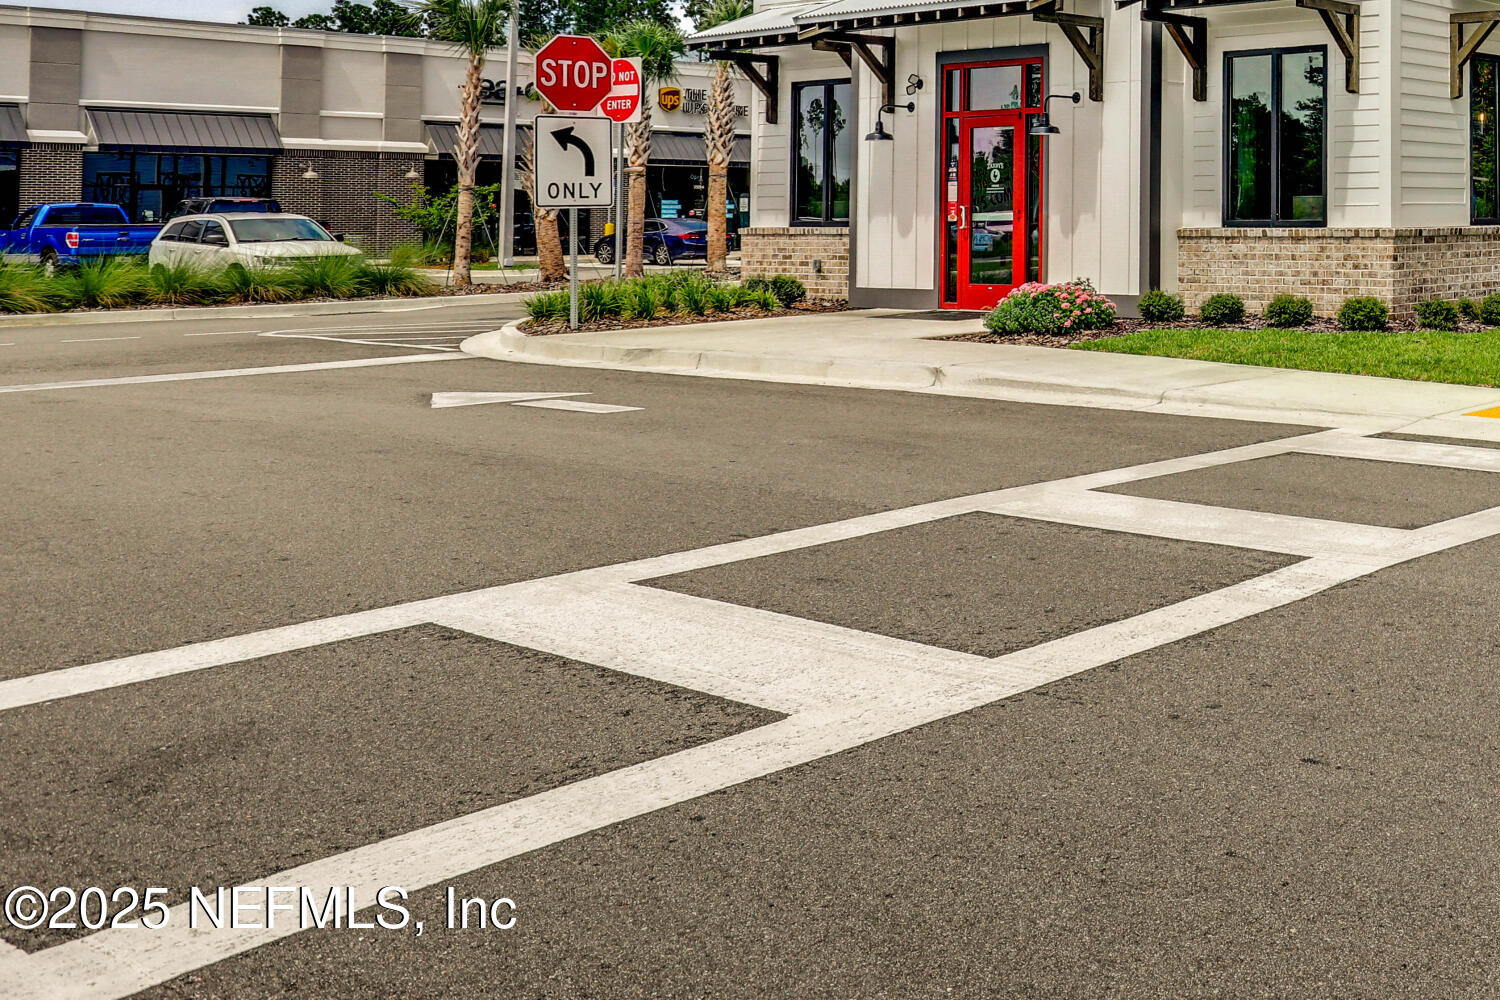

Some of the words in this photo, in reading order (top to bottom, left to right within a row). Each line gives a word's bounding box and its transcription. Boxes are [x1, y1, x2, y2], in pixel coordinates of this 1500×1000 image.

[540, 58, 608, 89] STOP
[619, 71, 635, 81] NOT
[607, 99, 631, 110] ENTER
[661, 94, 679, 109] ups
[547, 182, 603, 199] ONLY
